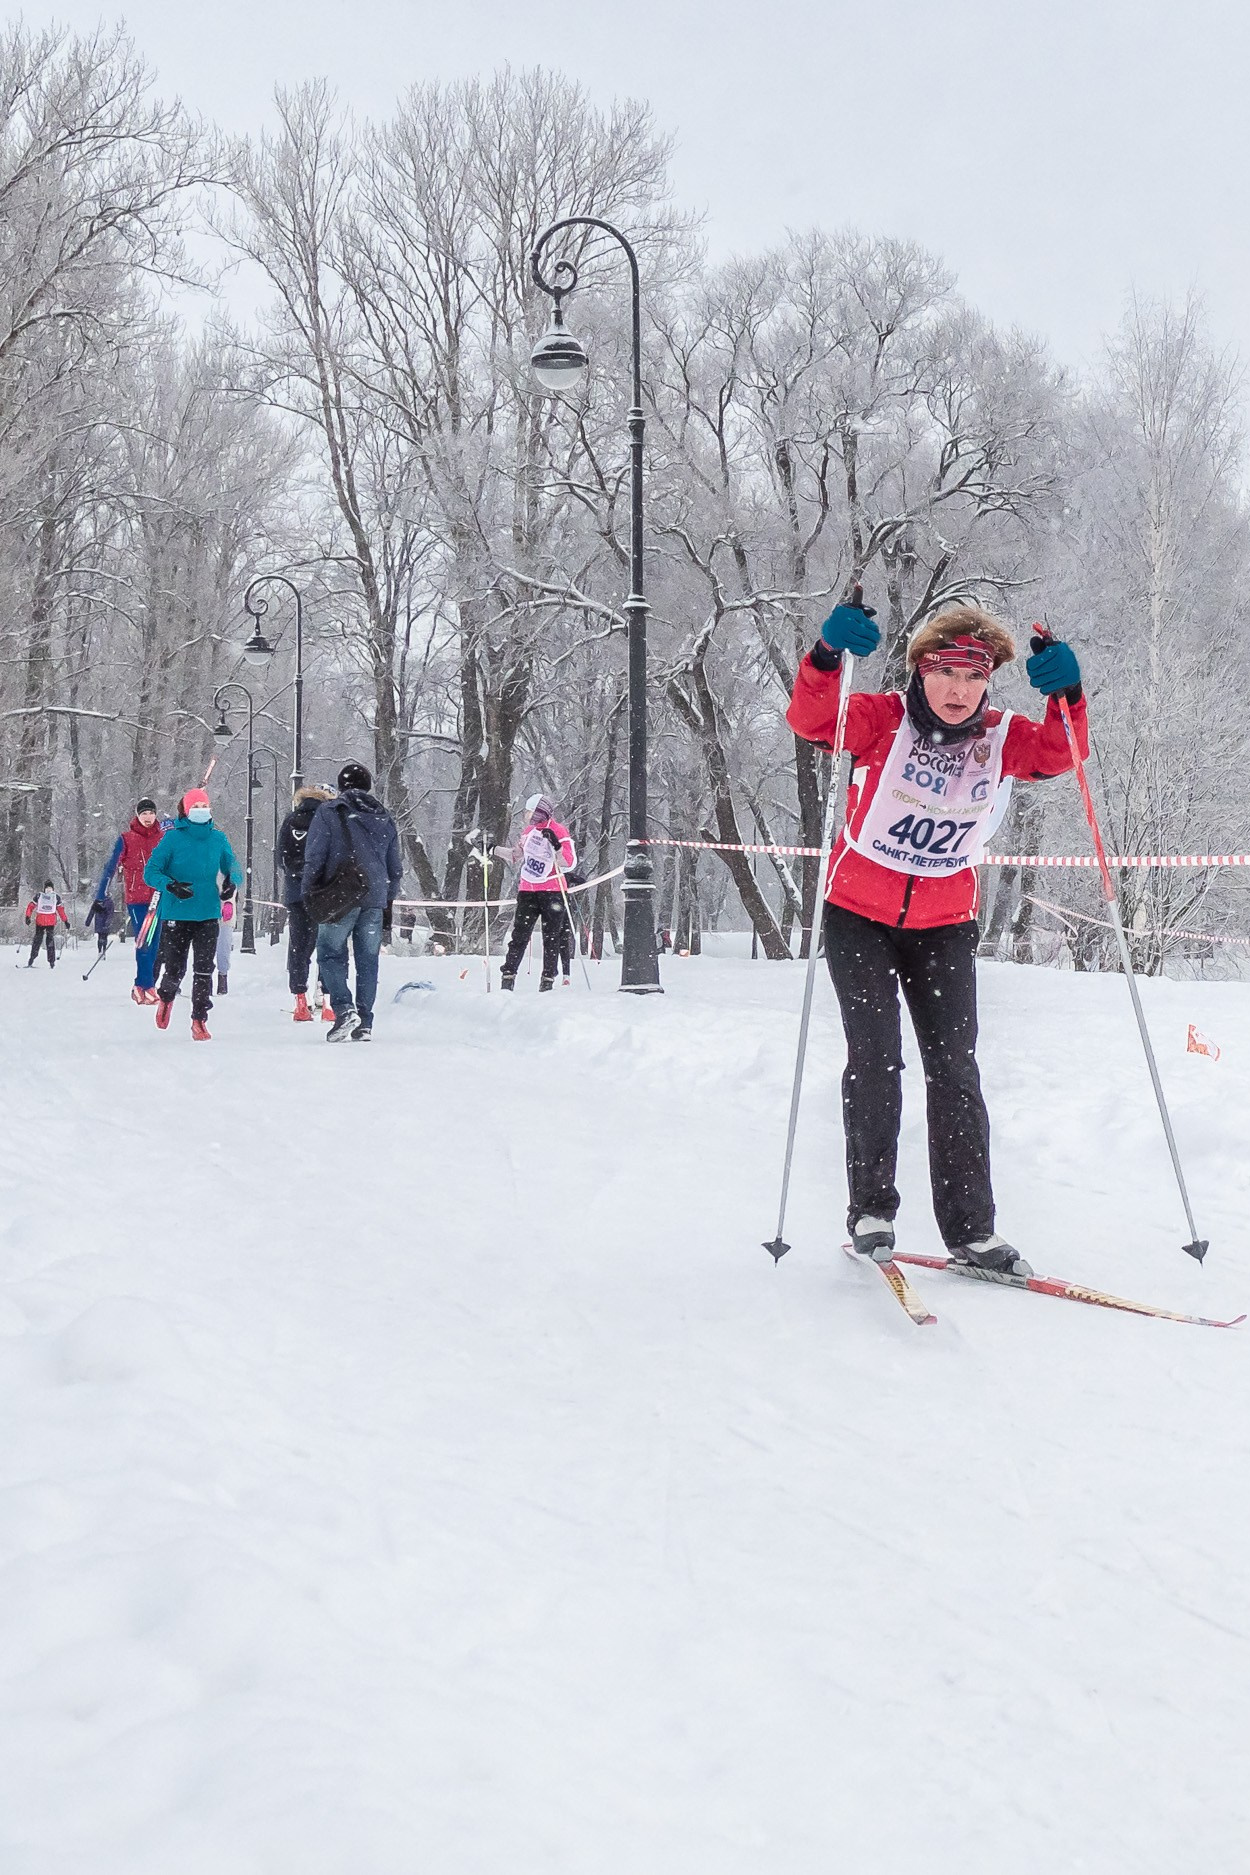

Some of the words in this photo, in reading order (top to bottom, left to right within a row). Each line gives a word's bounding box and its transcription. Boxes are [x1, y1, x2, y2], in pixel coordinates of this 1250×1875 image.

[913, 736, 966, 763] ЛЫНЯ
[888, 814, 977, 854] 4027
[872, 839, 970, 868] САНКТ-ПЕТЕРБУРГ
